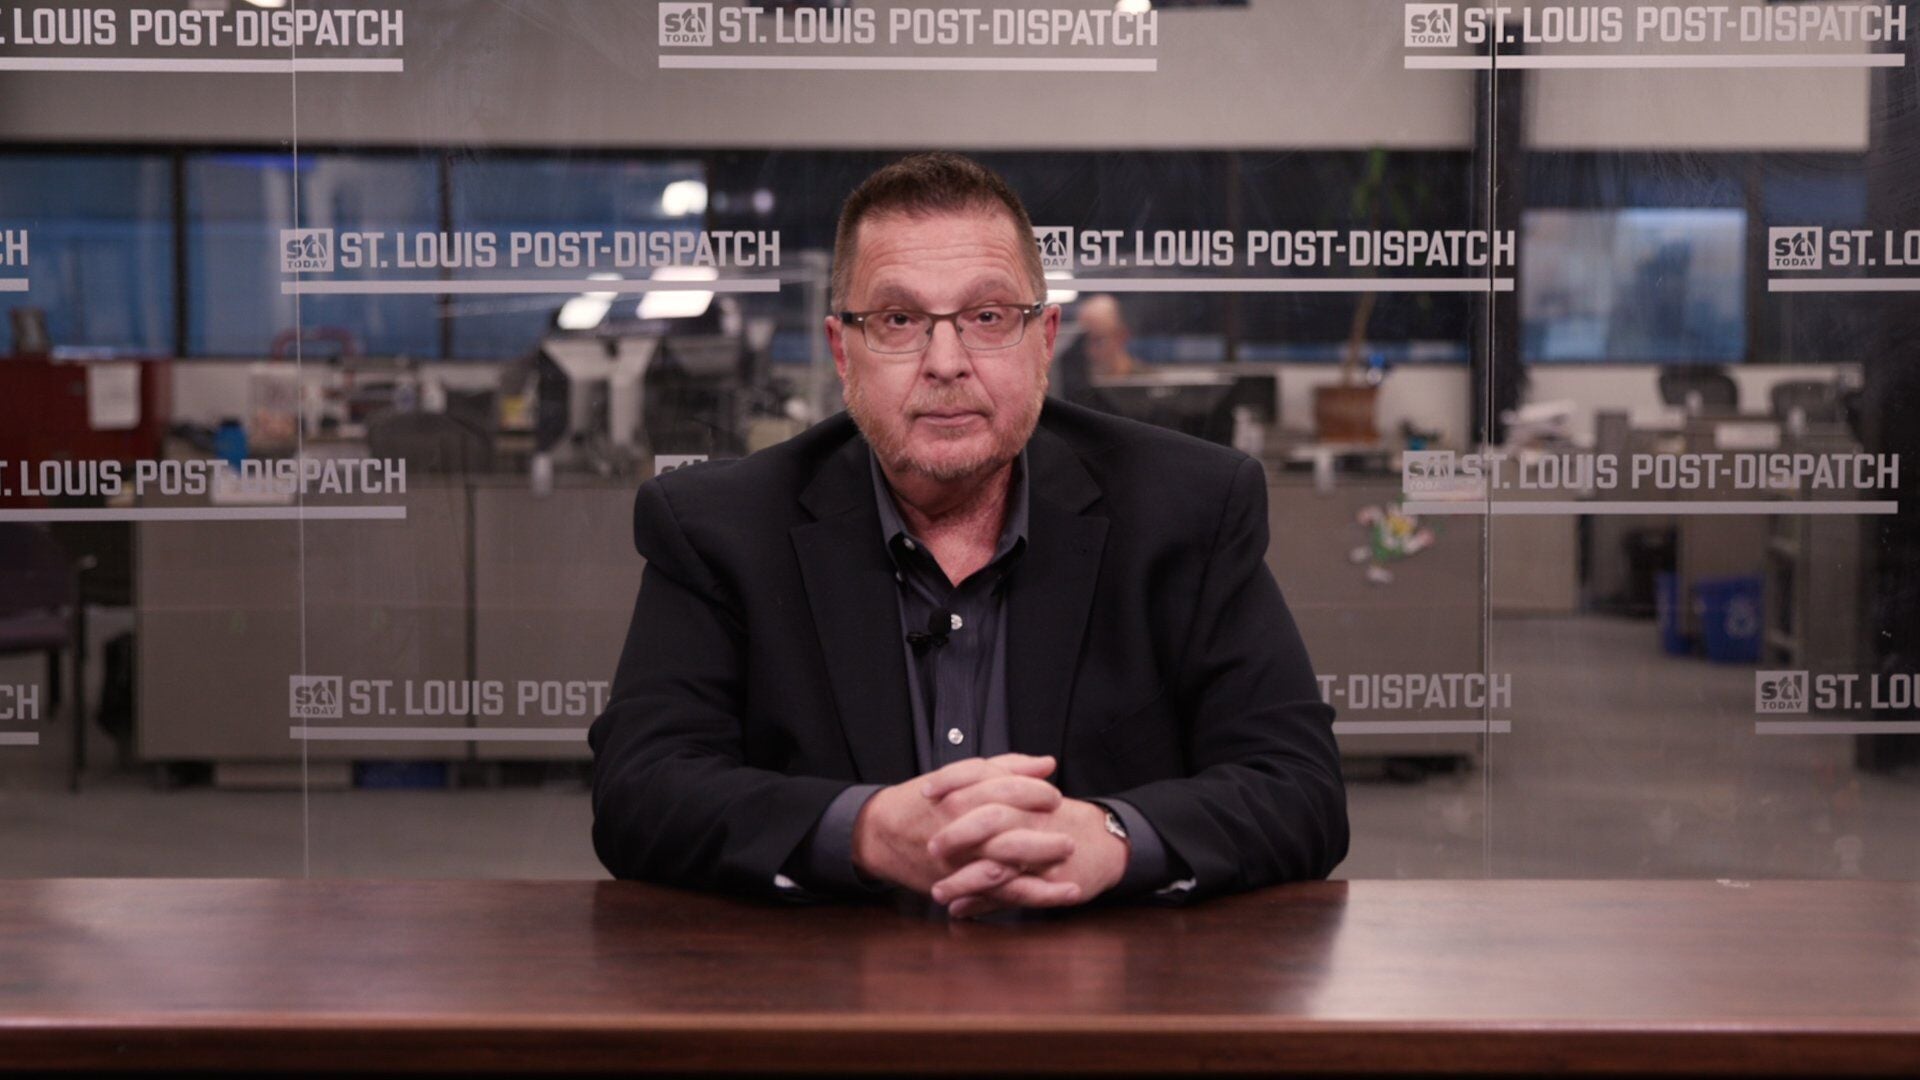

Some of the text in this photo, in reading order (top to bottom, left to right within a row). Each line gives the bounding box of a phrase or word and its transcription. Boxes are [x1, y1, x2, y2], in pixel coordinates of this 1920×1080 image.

[14, 8, 116, 44] LOUIS
[131, 9, 403, 46] POST-DISPATCH
[665, 34, 706, 43] TODAY
[719, 7, 1158, 46] ST. LOUIS POST-DISPATCH
[1411, 34, 1451, 43] TODAY
[1464, 5, 1906, 43] ST. LOUIS POST-DISPATCH
[287, 260, 327, 268] TODAY
[340, 230, 780, 268] ST. LOUIS POST-DISPATCH
[1080, 230, 1515, 266] ST. LOUIS POST-DISPATCH
[1775, 258, 1816, 266] TODAY
[1829, 230, 1876, 266] ST.
[20, 460, 122, 496] LOUIS
[1461, 453, 1899, 489] ST. LOUIS POST-DISPATCH
[350, 680, 396, 715] ST.
[405, 680, 504, 715] LOUIS
[1762, 701, 1802, 709] TODAY
[1815, 674, 1861, 709] ST.
[296, 706, 336, 715] TODAY
